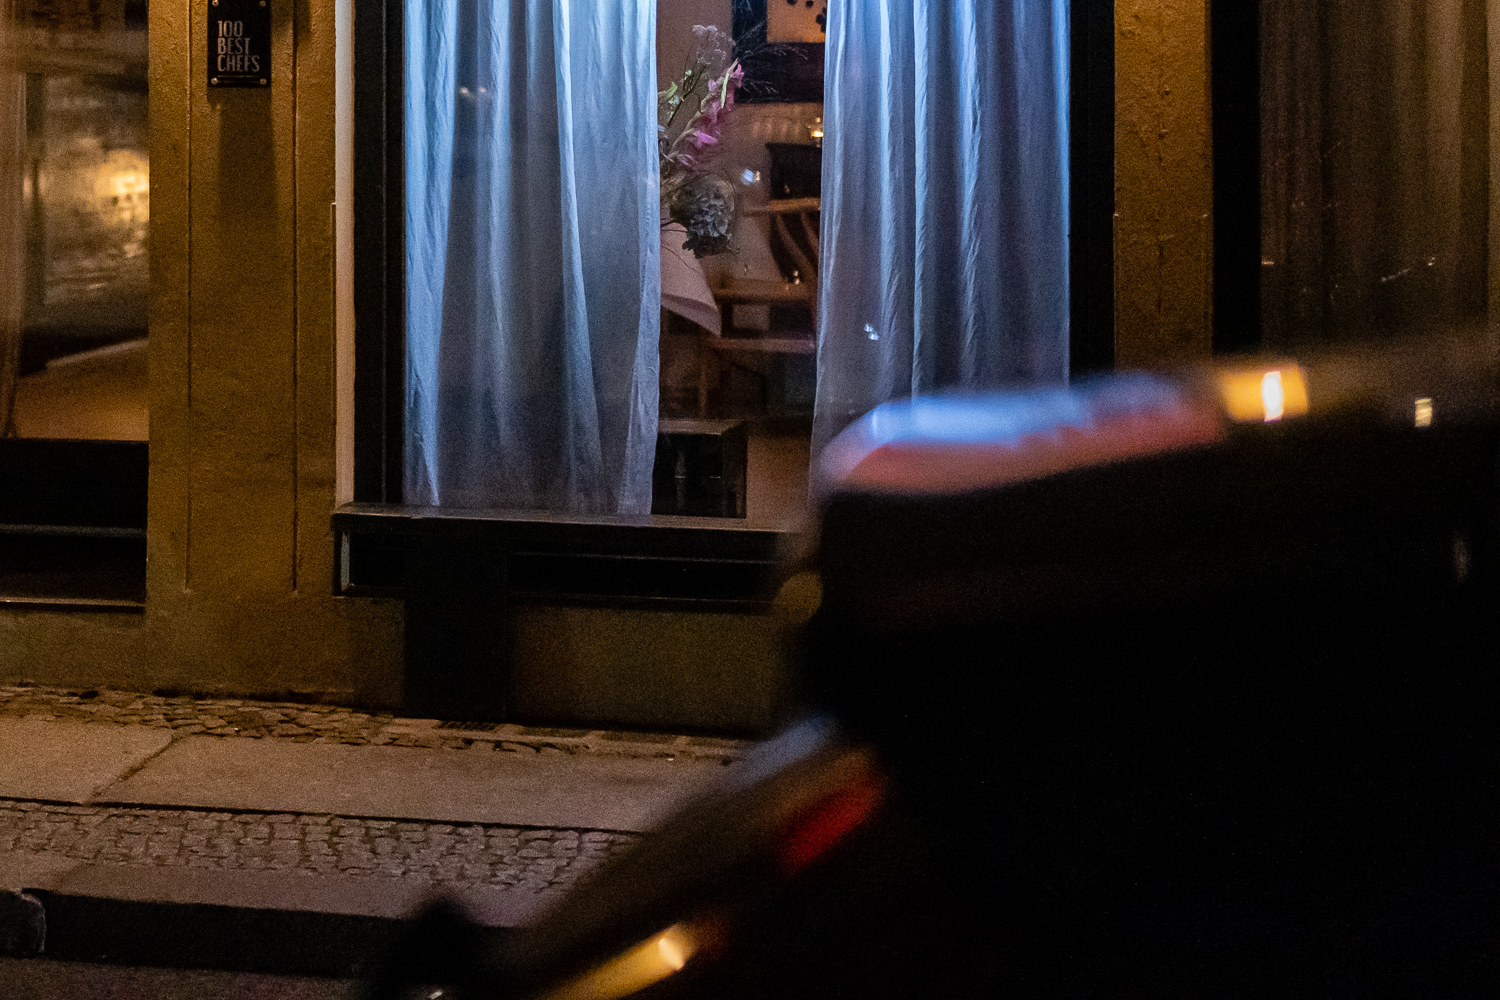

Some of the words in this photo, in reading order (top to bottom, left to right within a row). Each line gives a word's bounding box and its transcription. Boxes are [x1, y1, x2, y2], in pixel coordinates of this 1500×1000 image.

[217, 20, 244, 37] 100
[217, 37, 251, 55] BEST
[217, 55, 260, 72] CHEFS
